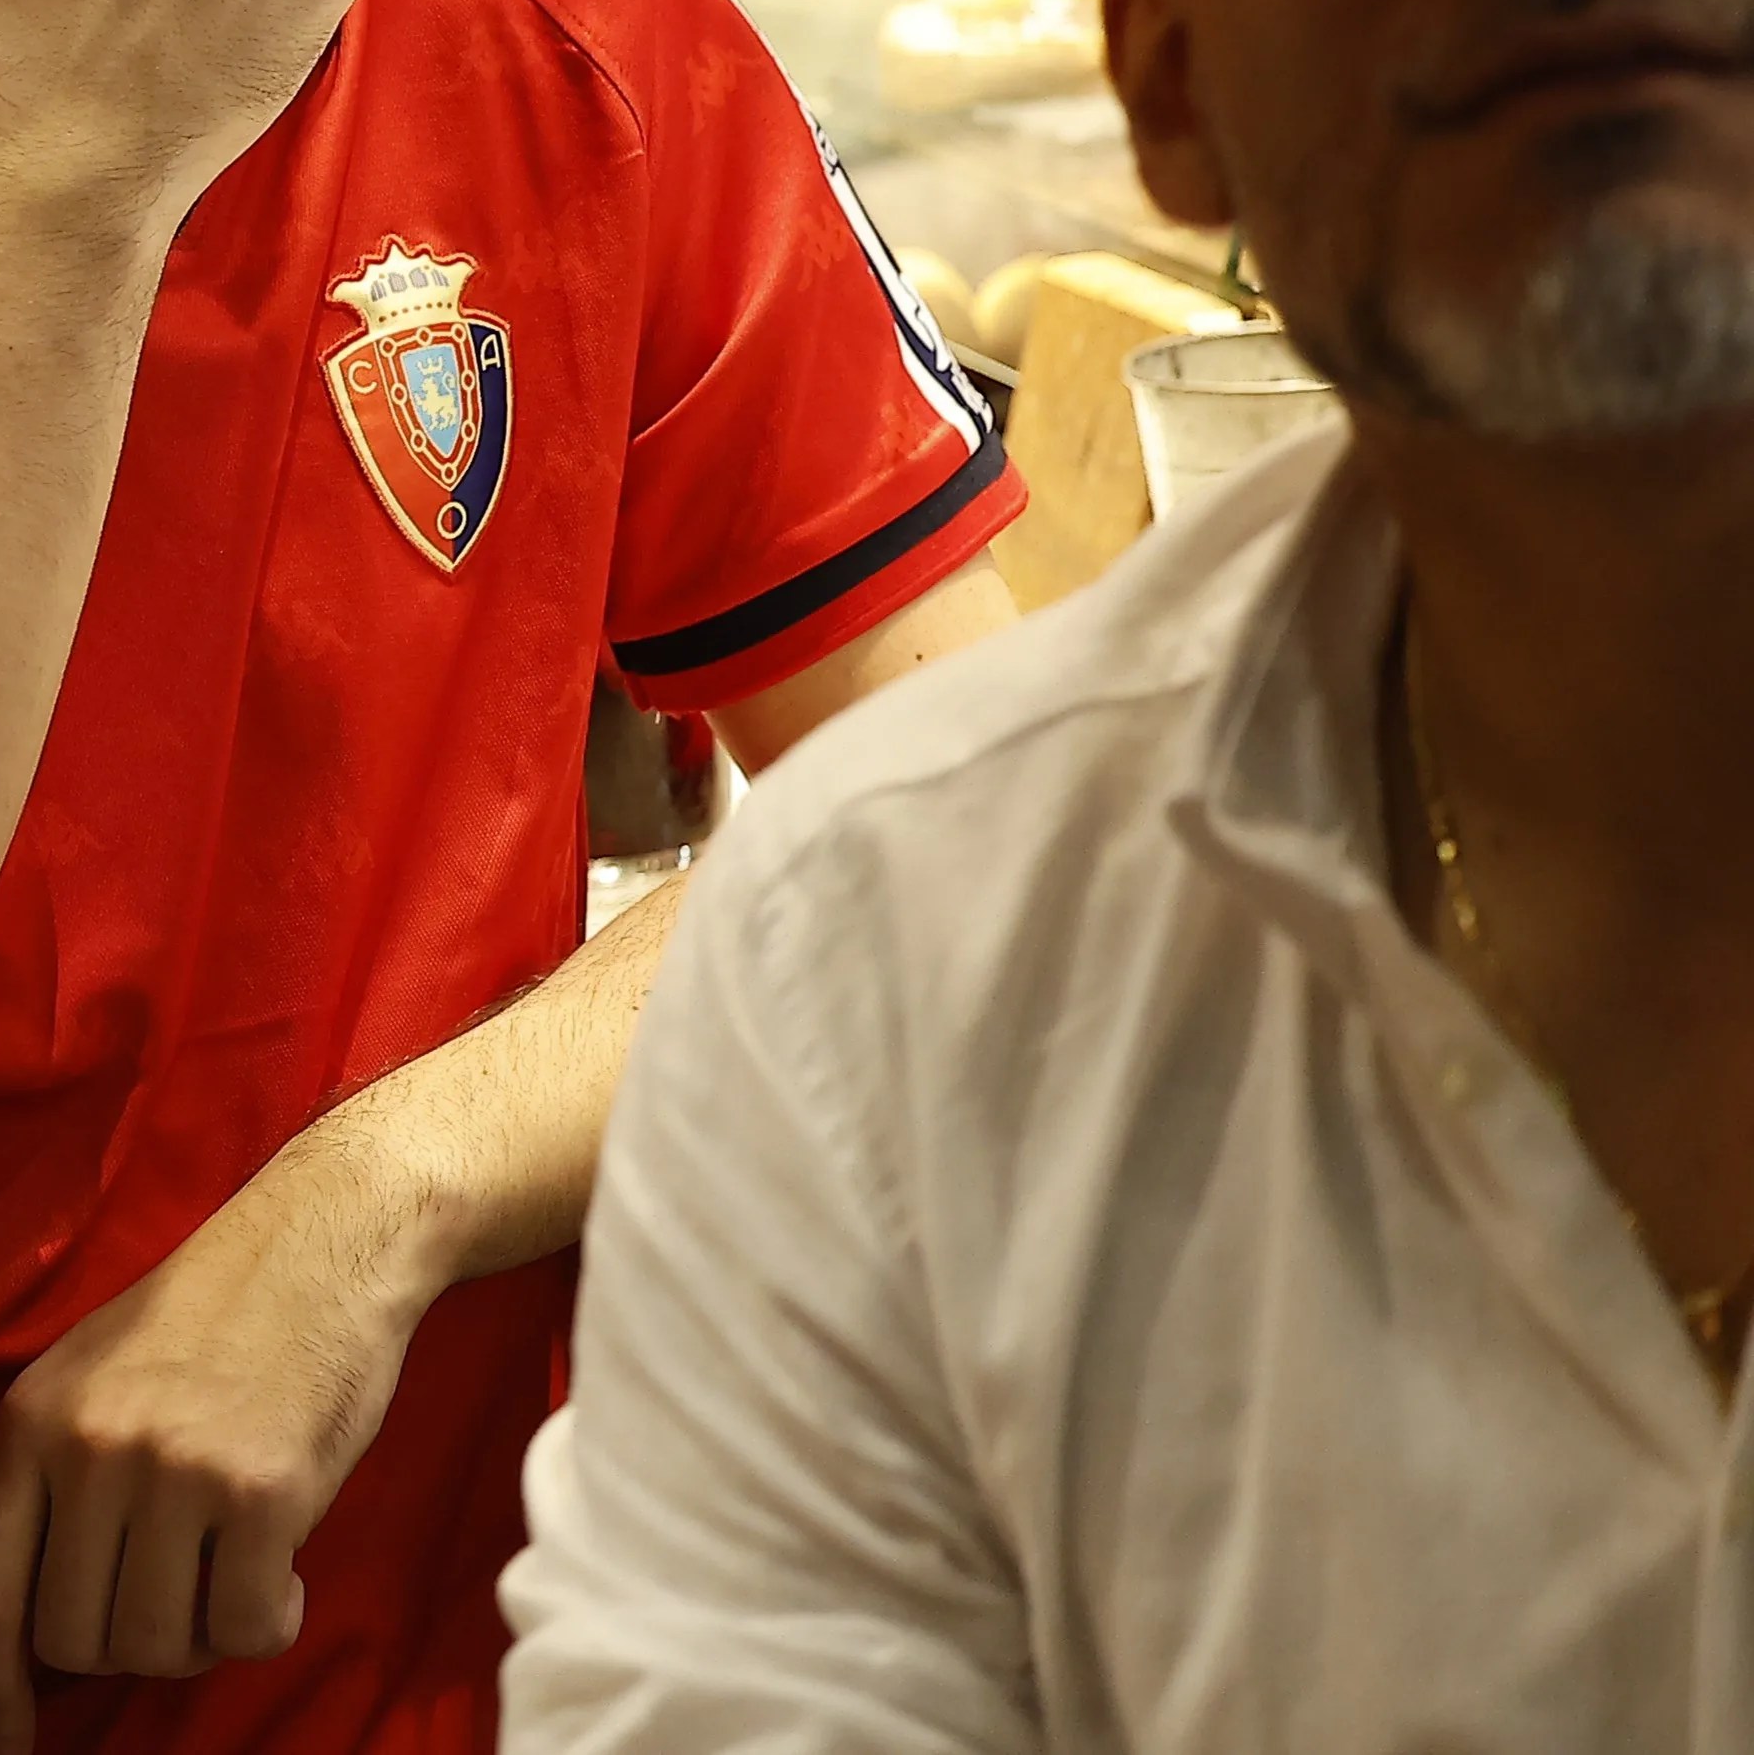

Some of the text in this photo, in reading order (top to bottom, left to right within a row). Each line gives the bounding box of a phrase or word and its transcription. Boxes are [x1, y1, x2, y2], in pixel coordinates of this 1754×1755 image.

[348, 334, 501, 394] C A
[438, 501, 467, 539] O
